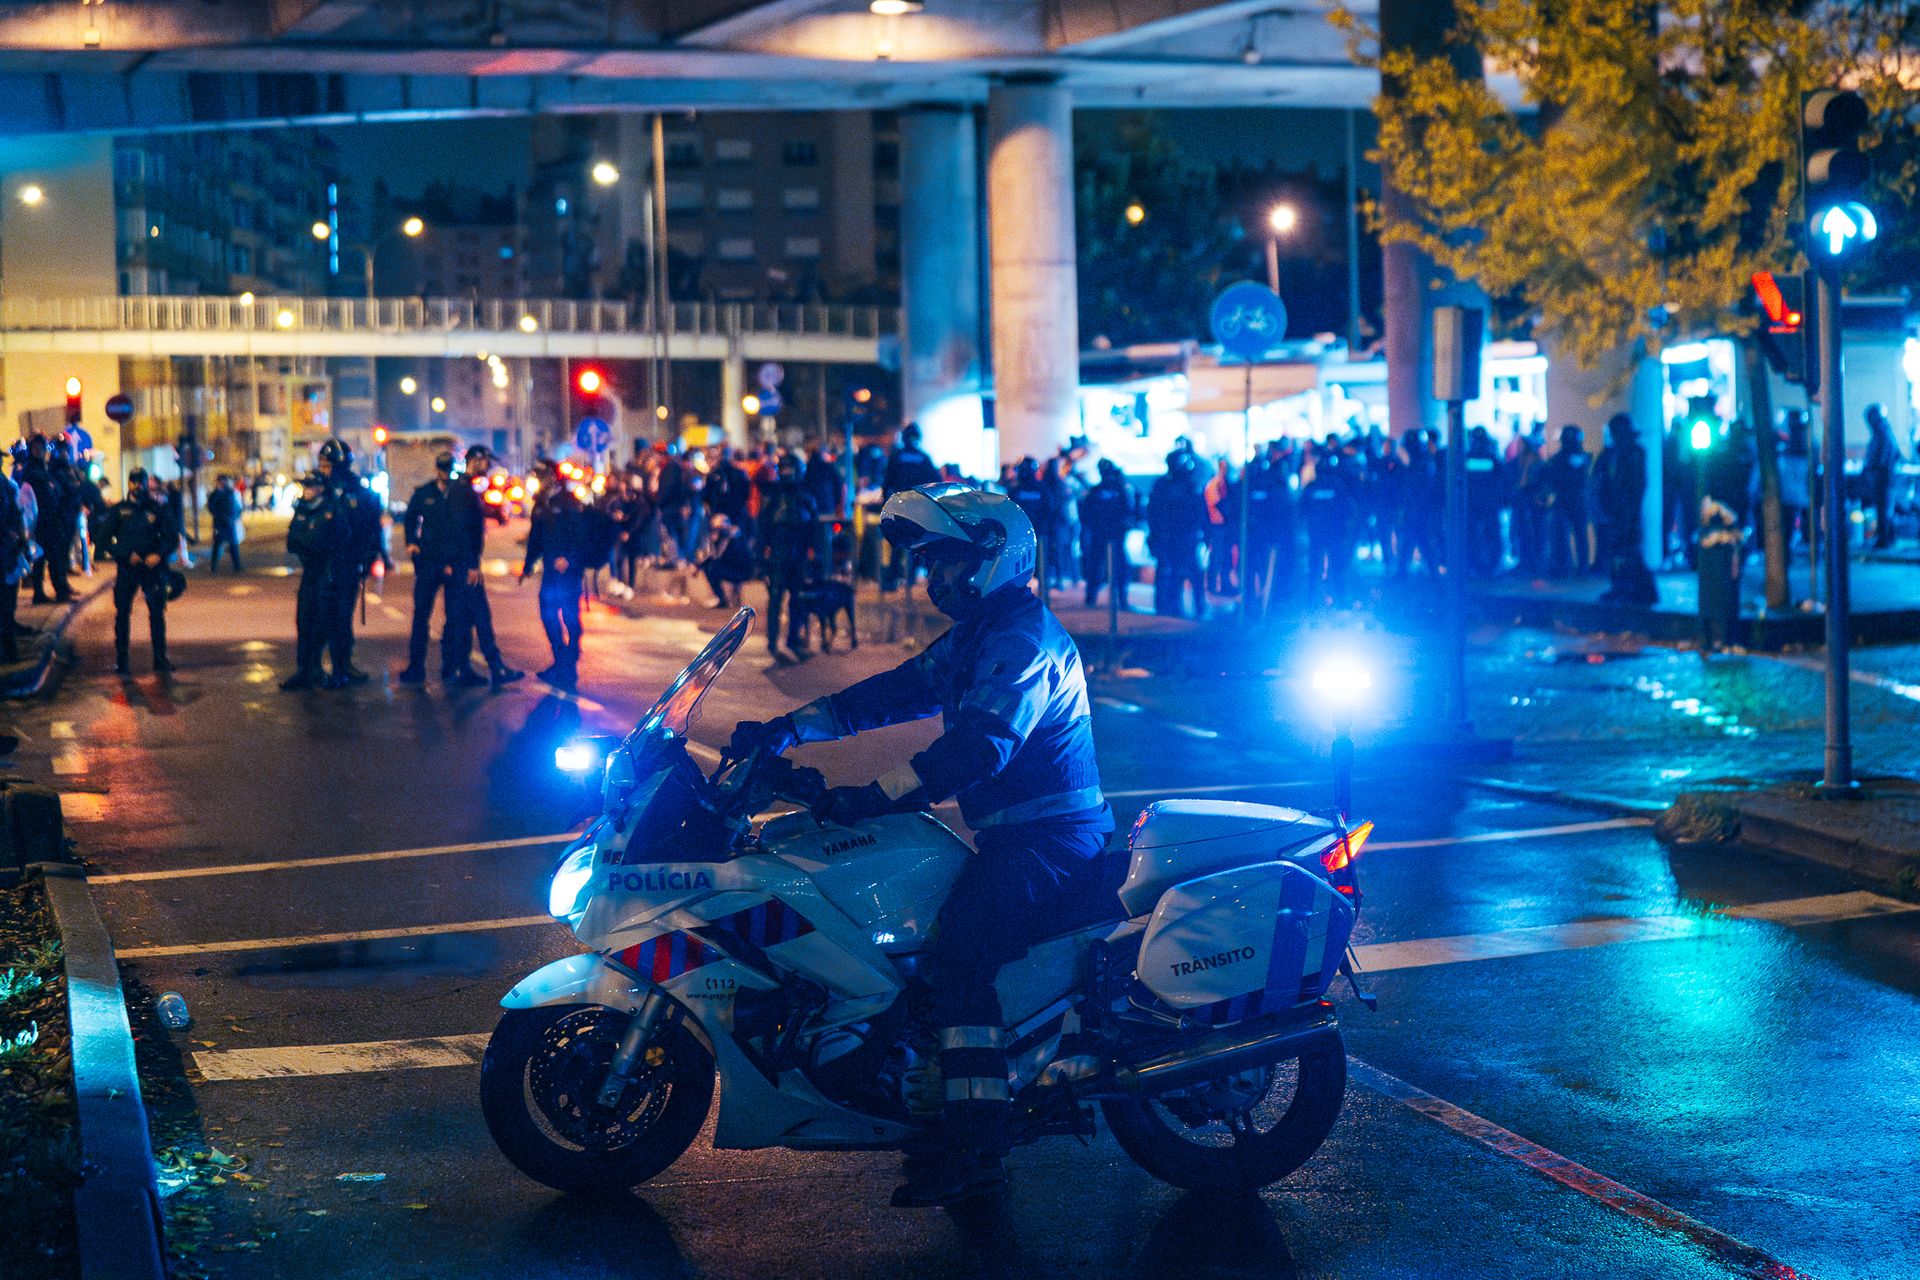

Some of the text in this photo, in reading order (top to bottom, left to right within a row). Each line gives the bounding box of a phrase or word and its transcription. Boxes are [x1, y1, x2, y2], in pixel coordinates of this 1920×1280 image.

[822, 834, 876, 856] YAMAHA
[608, 867, 711, 891] POLÍCIA
[1171, 946, 1255, 976] TRÂNSITO
